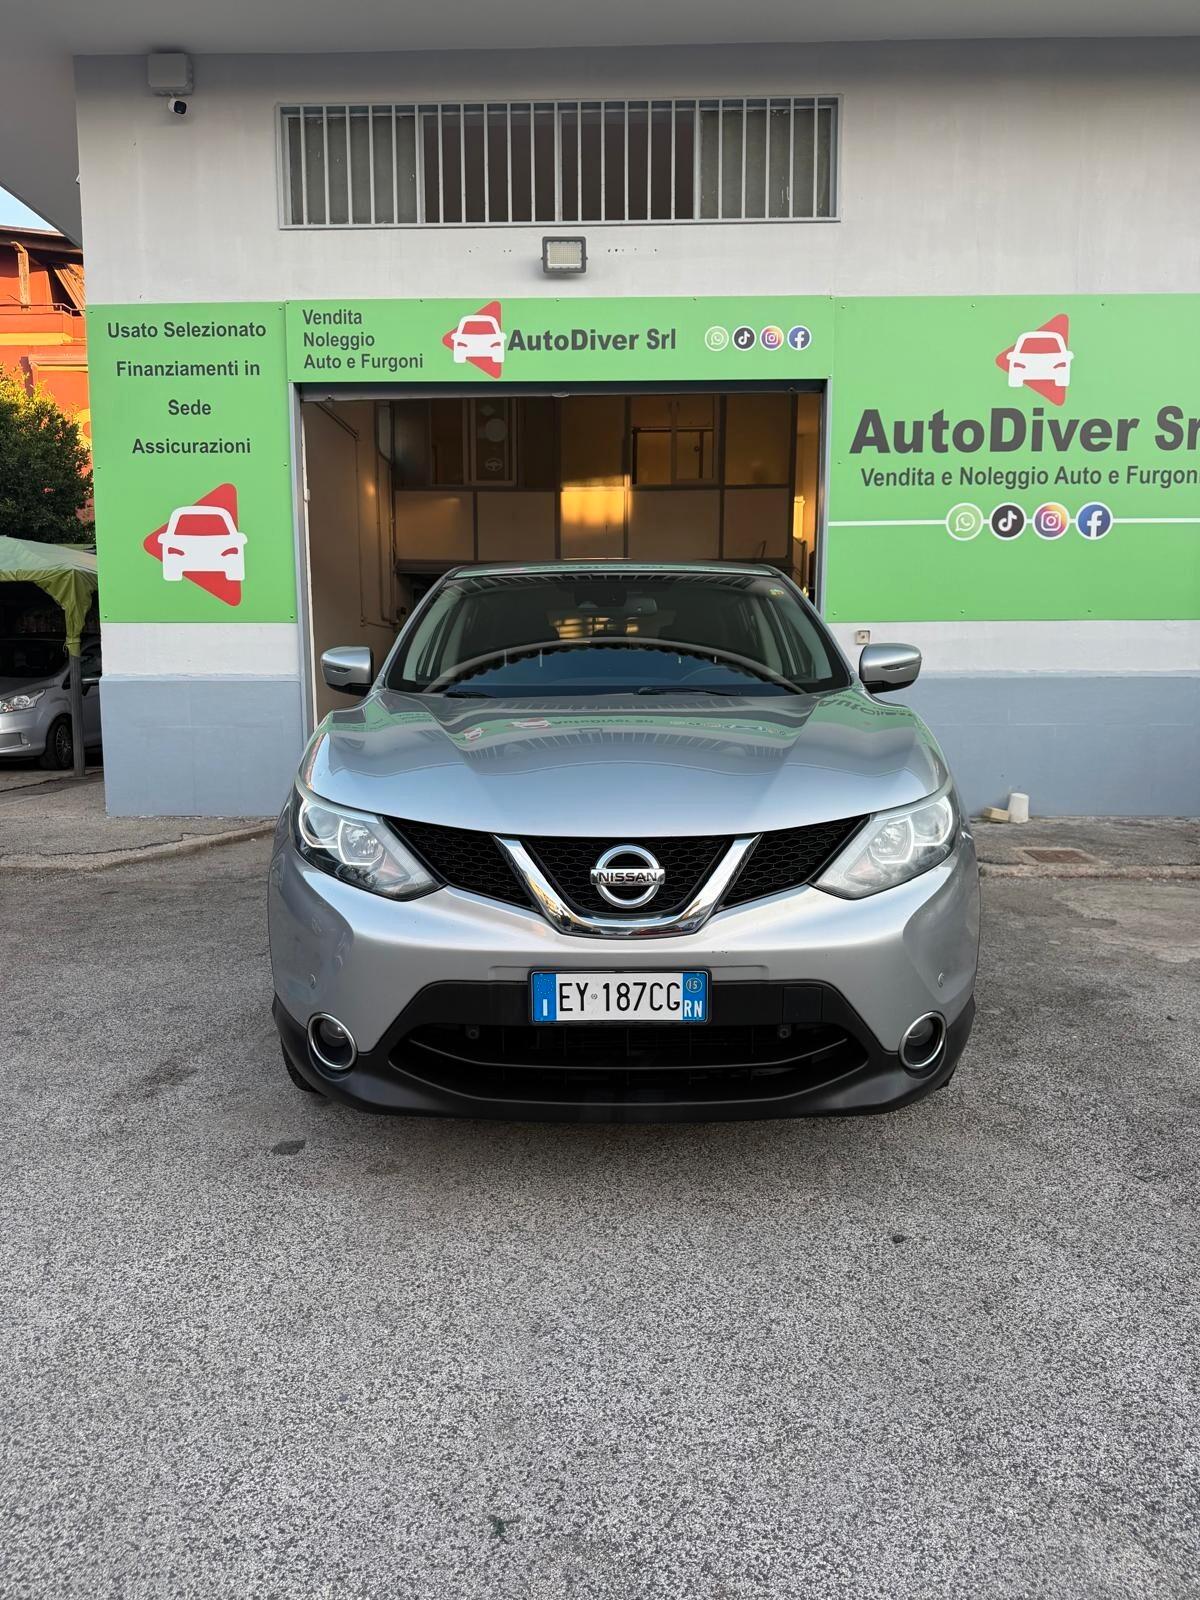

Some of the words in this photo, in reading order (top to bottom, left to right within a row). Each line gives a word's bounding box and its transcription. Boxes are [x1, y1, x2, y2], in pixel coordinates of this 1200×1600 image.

[302, 308, 363, 326] Vendita
[107, 322, 158, 338] Usato
[163, 320, 267, 338] Selezionato
[303, 332, 376, 350] Noleggio
[507, 327, 639, 351] AutoDiver
[646, 327, 676, 350] Srl
[116, 360, 239, 377] Finanziamenti
[244, 360, 261, 376] in
[303, 354, 342, 370] Auto
[346, 356, 356, 370] e
[361, 353, 423, 373] Furgoni
[168, 398, 212, 416] Sede
[849, 407, 1140, 454] AutoDiver
[132, 437, 251, 454] Assicurazioni
[861, 467, 935, 487] Vendita
[941, 471, 953, 486] e
[959, 465, 1049, 490] Noleggio
[1054, 465, 1102, 486] Auto
[1108, 470, 1120, 485] e
[1126, 465, 1200, 489] Furgon
[598, 872, 657, 884] NISSAN
[558, 982, 589, 1012] EY
[602, 982, 681, 1012] 187CG
[543, 998, 548, 1016] I
[683, 999, 703, 1018] RN
